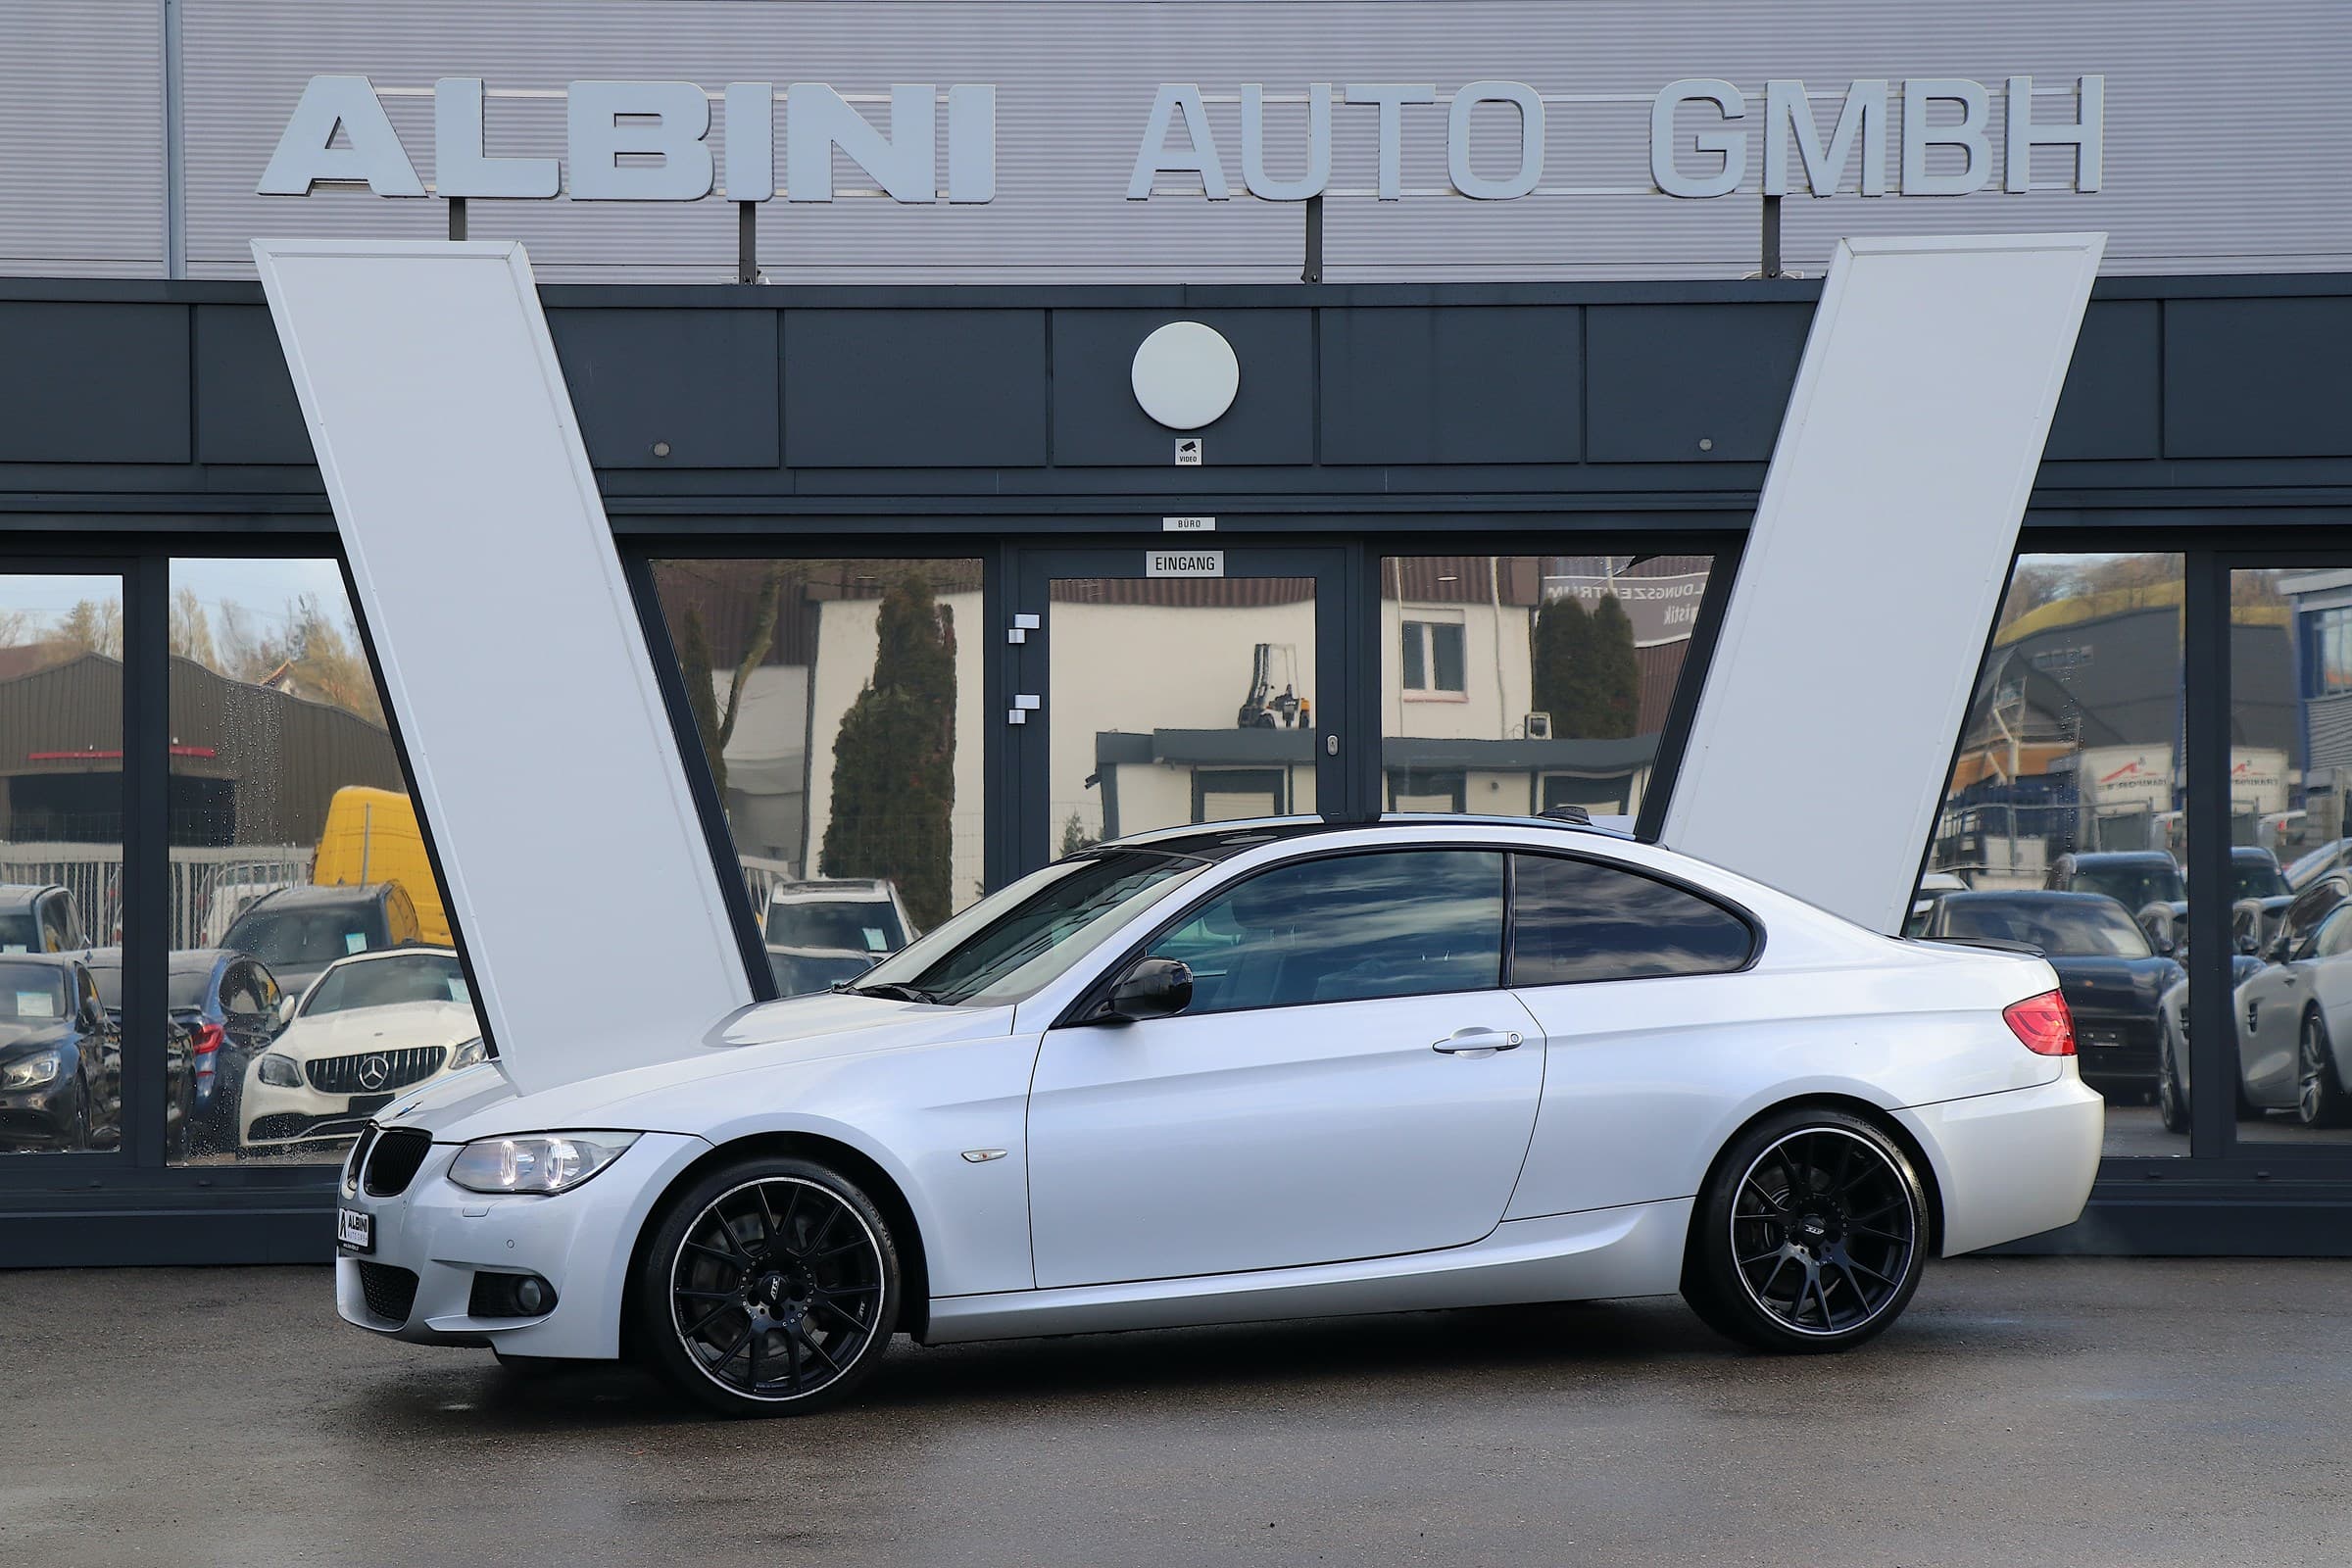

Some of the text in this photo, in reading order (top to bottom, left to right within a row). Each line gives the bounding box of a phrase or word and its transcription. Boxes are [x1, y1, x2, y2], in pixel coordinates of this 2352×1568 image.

[256, 74, 2105, 204] ALBINI AUTO GMBH
[1178, 519, 1201, 528] BÜRO
[1155, 557, 1215, 570] EINGANG
[348, 1214, 368, 1233] ALBINI
